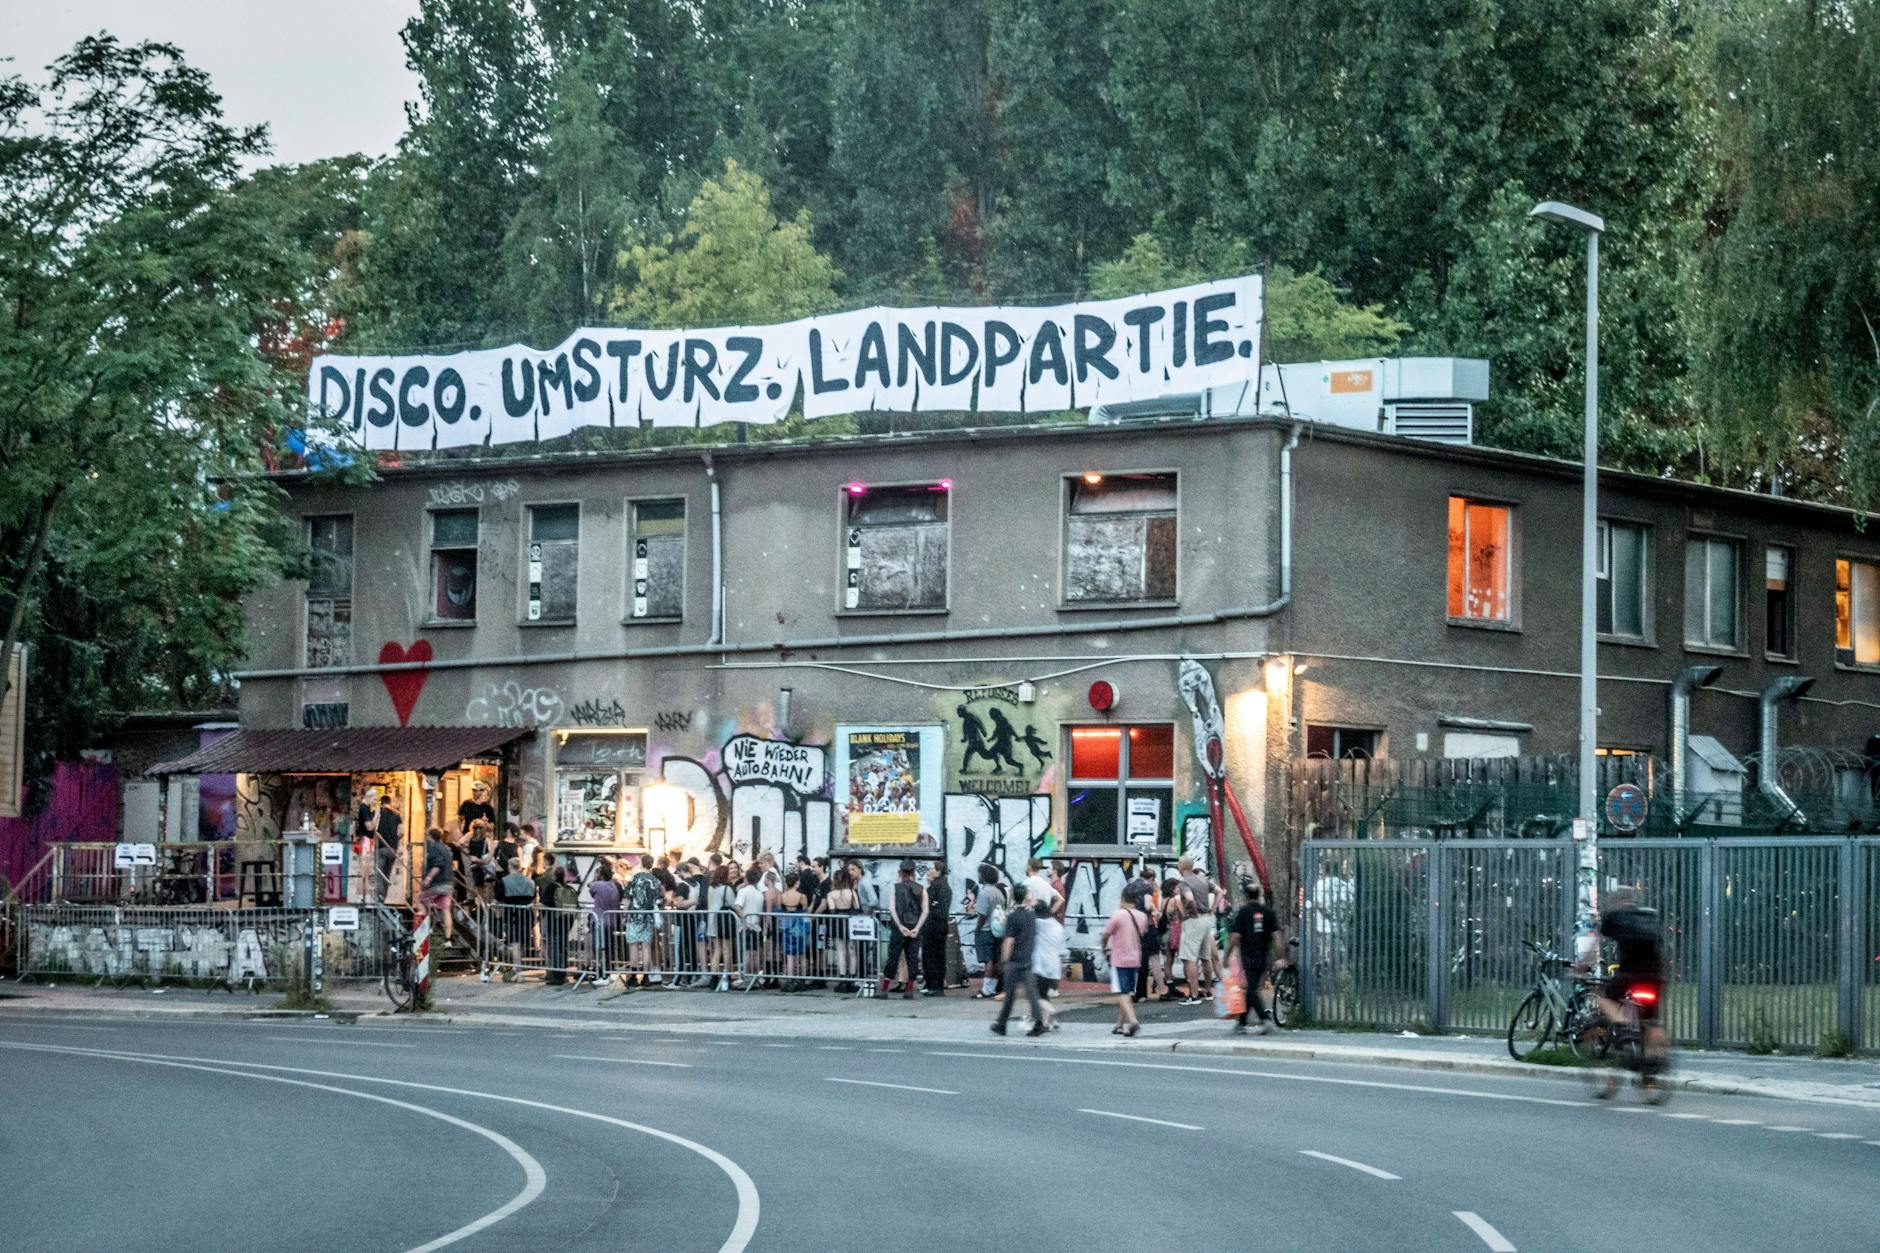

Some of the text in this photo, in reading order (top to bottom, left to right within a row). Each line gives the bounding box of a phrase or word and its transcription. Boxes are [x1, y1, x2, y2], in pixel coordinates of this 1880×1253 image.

[320, 291, 1253, 430] DISCO. UMSTURZ. LANDPARTIE.
